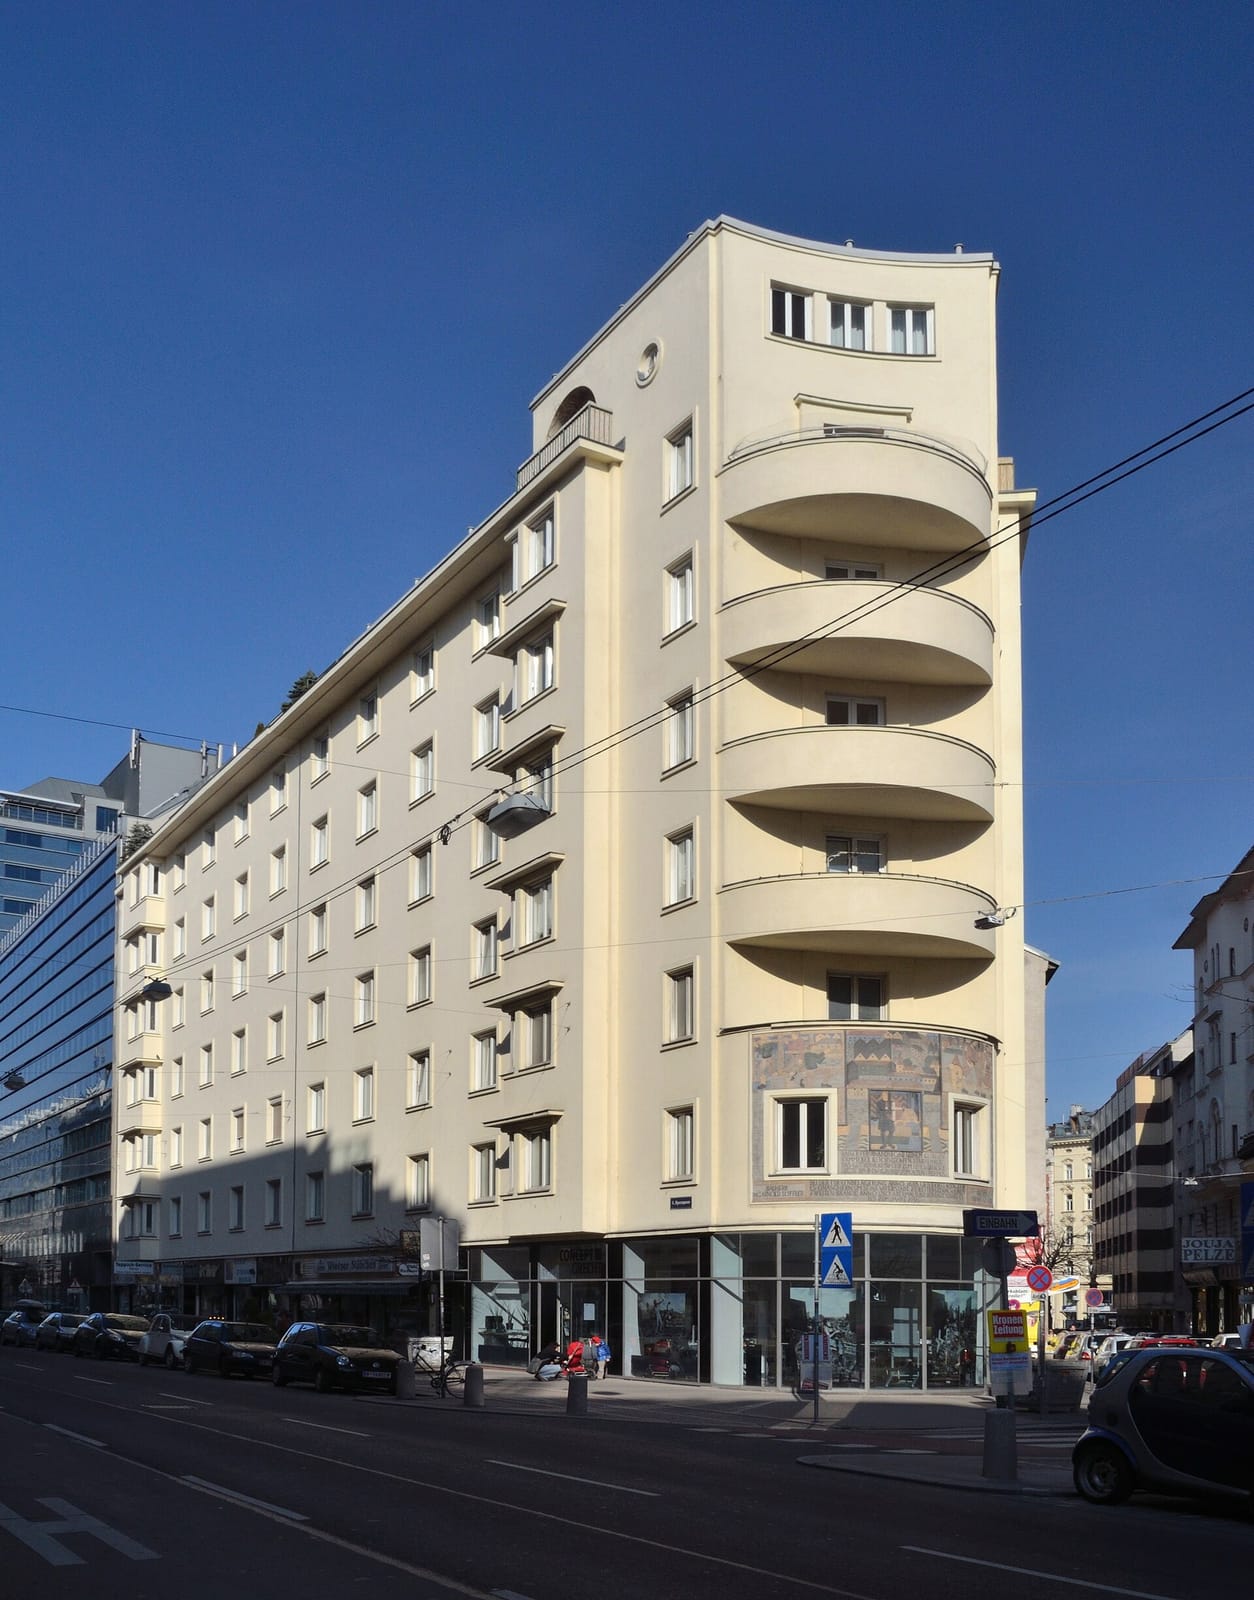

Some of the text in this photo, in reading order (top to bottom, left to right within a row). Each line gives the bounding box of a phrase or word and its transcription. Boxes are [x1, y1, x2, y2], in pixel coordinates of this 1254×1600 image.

[980, 1217, 1018, 1229] EINBAHN
[1183, 1239, 1234, 1249] JOUJA
[1183, 1249, 1235, 1261] PELZE
[992, 1314, 1023, 1325] Kronen
[994, 1325, 1024, 1336] Zeitung
